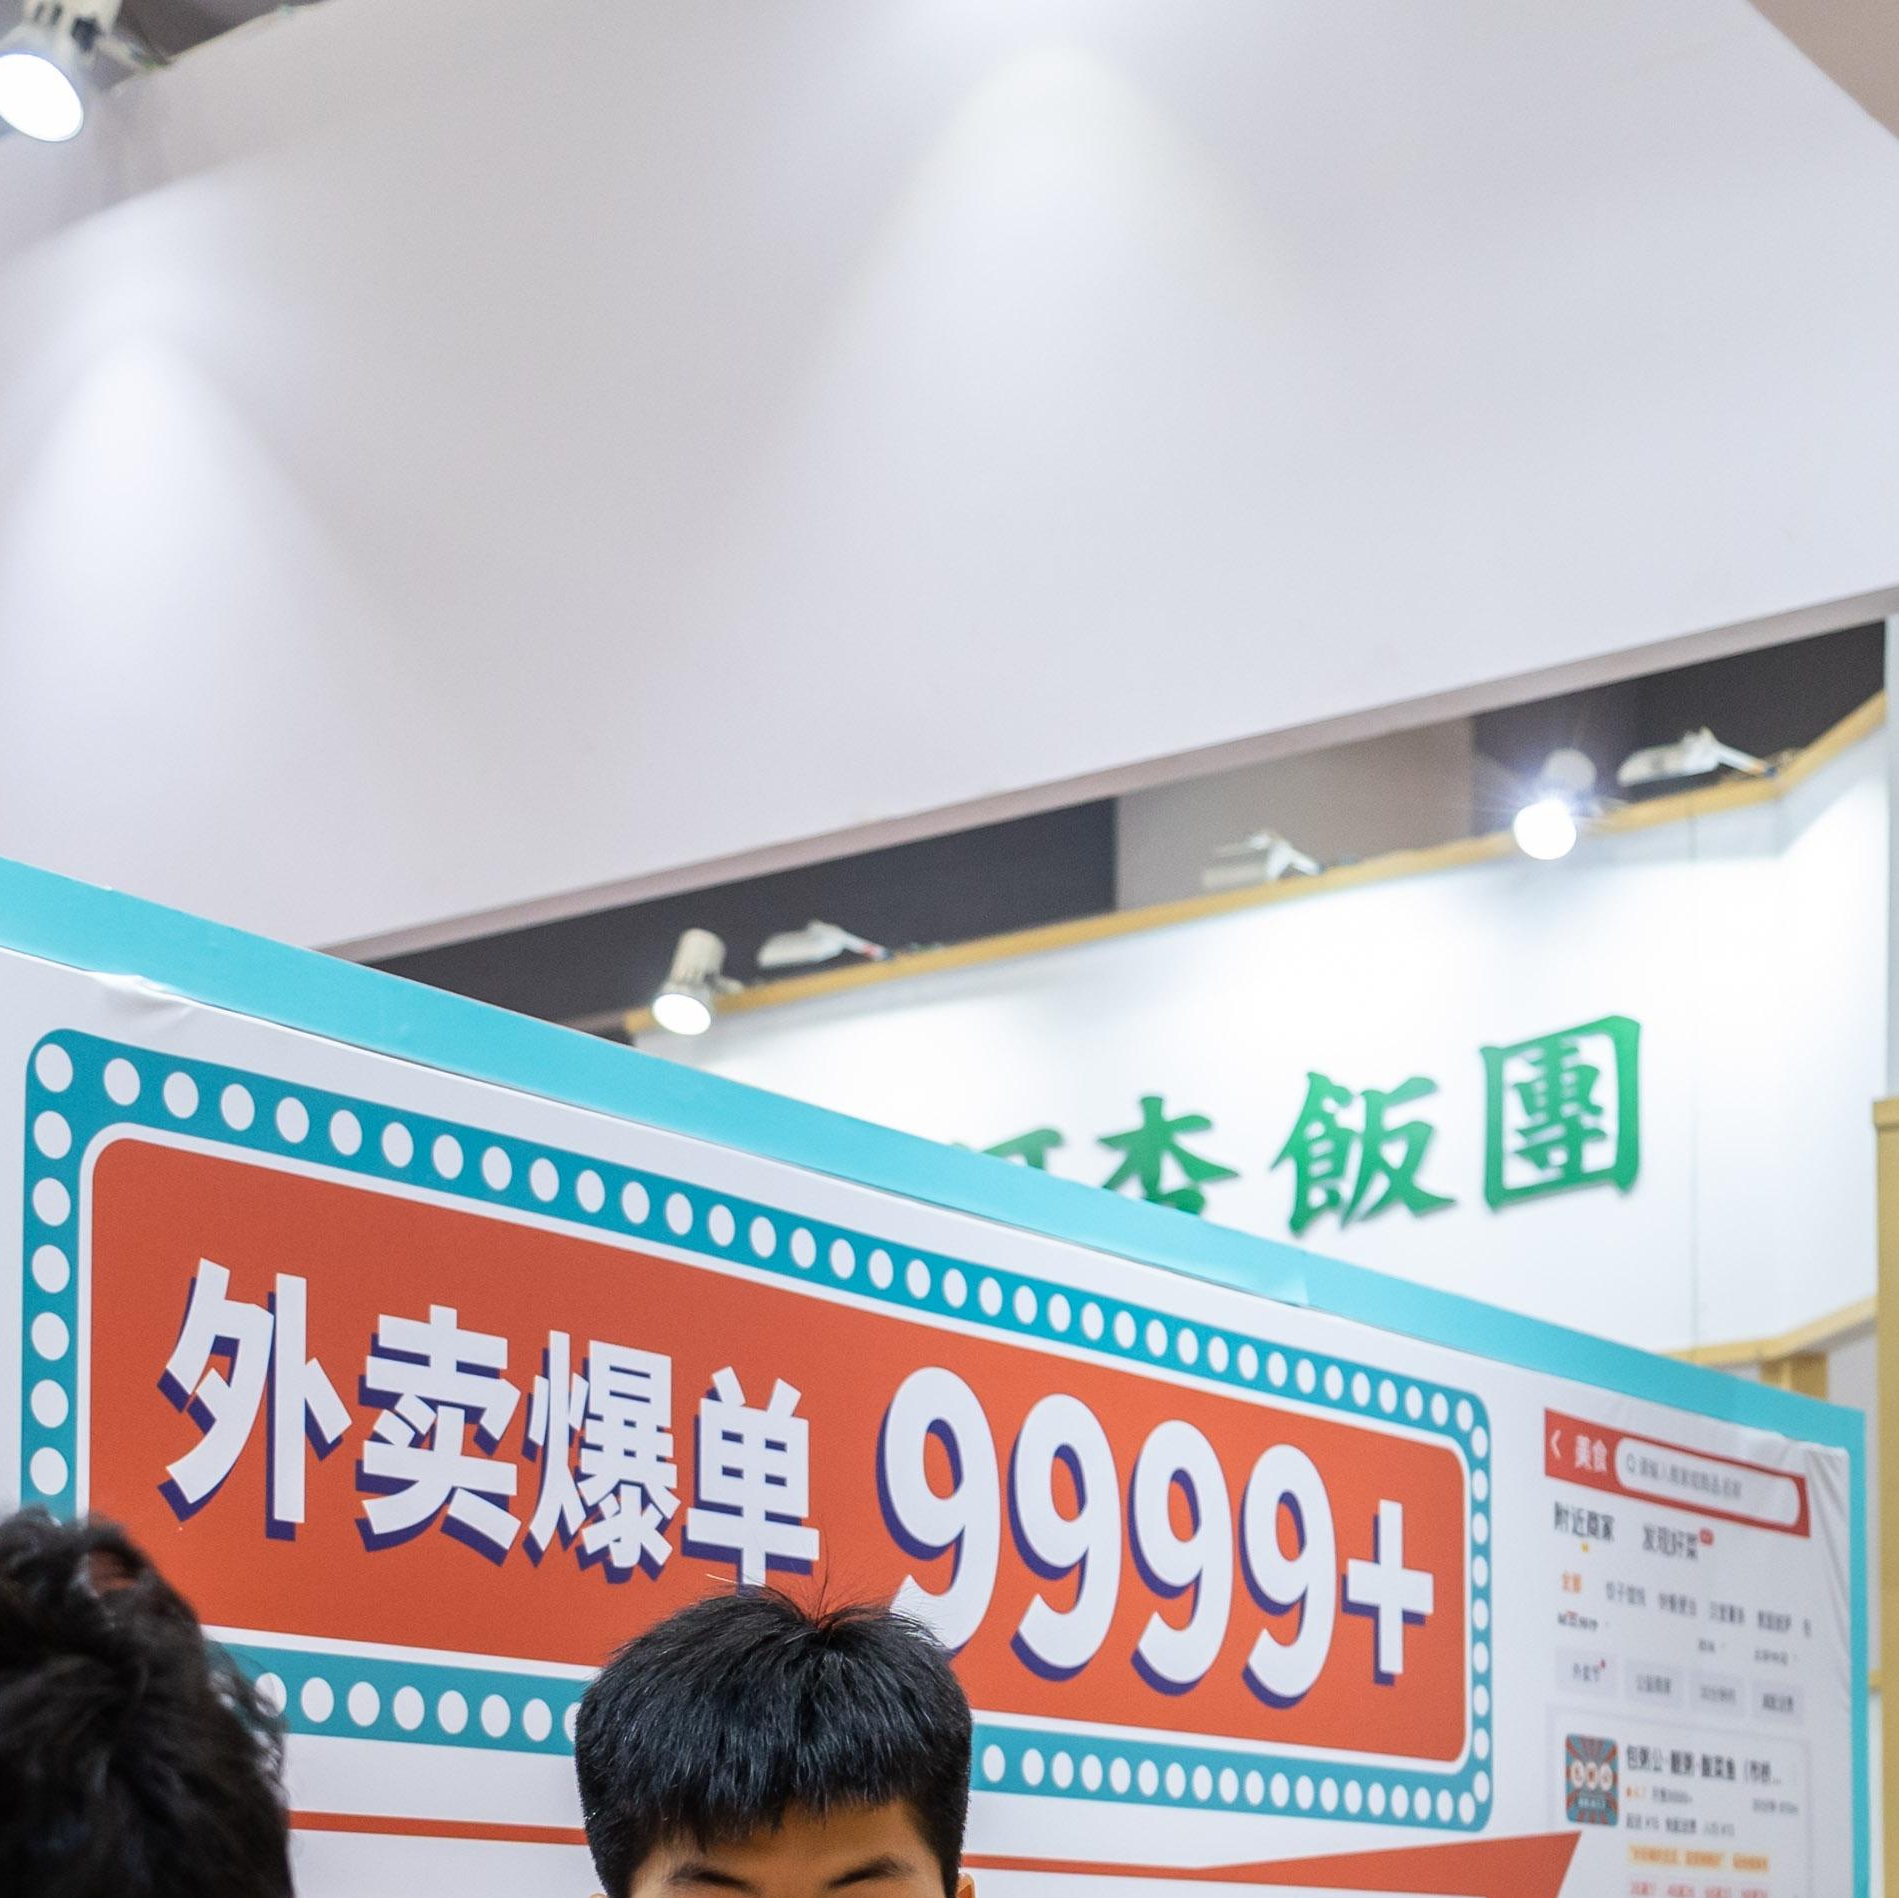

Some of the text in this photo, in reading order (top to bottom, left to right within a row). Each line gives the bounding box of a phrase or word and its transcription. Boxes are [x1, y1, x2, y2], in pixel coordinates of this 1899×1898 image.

[952, 1013, 1644, 1238] 杏飯團
[158, 1256, 1435, 1709] 外卖爆单 9999+
[1555, 1501, 1615, 1543] 附近商家
